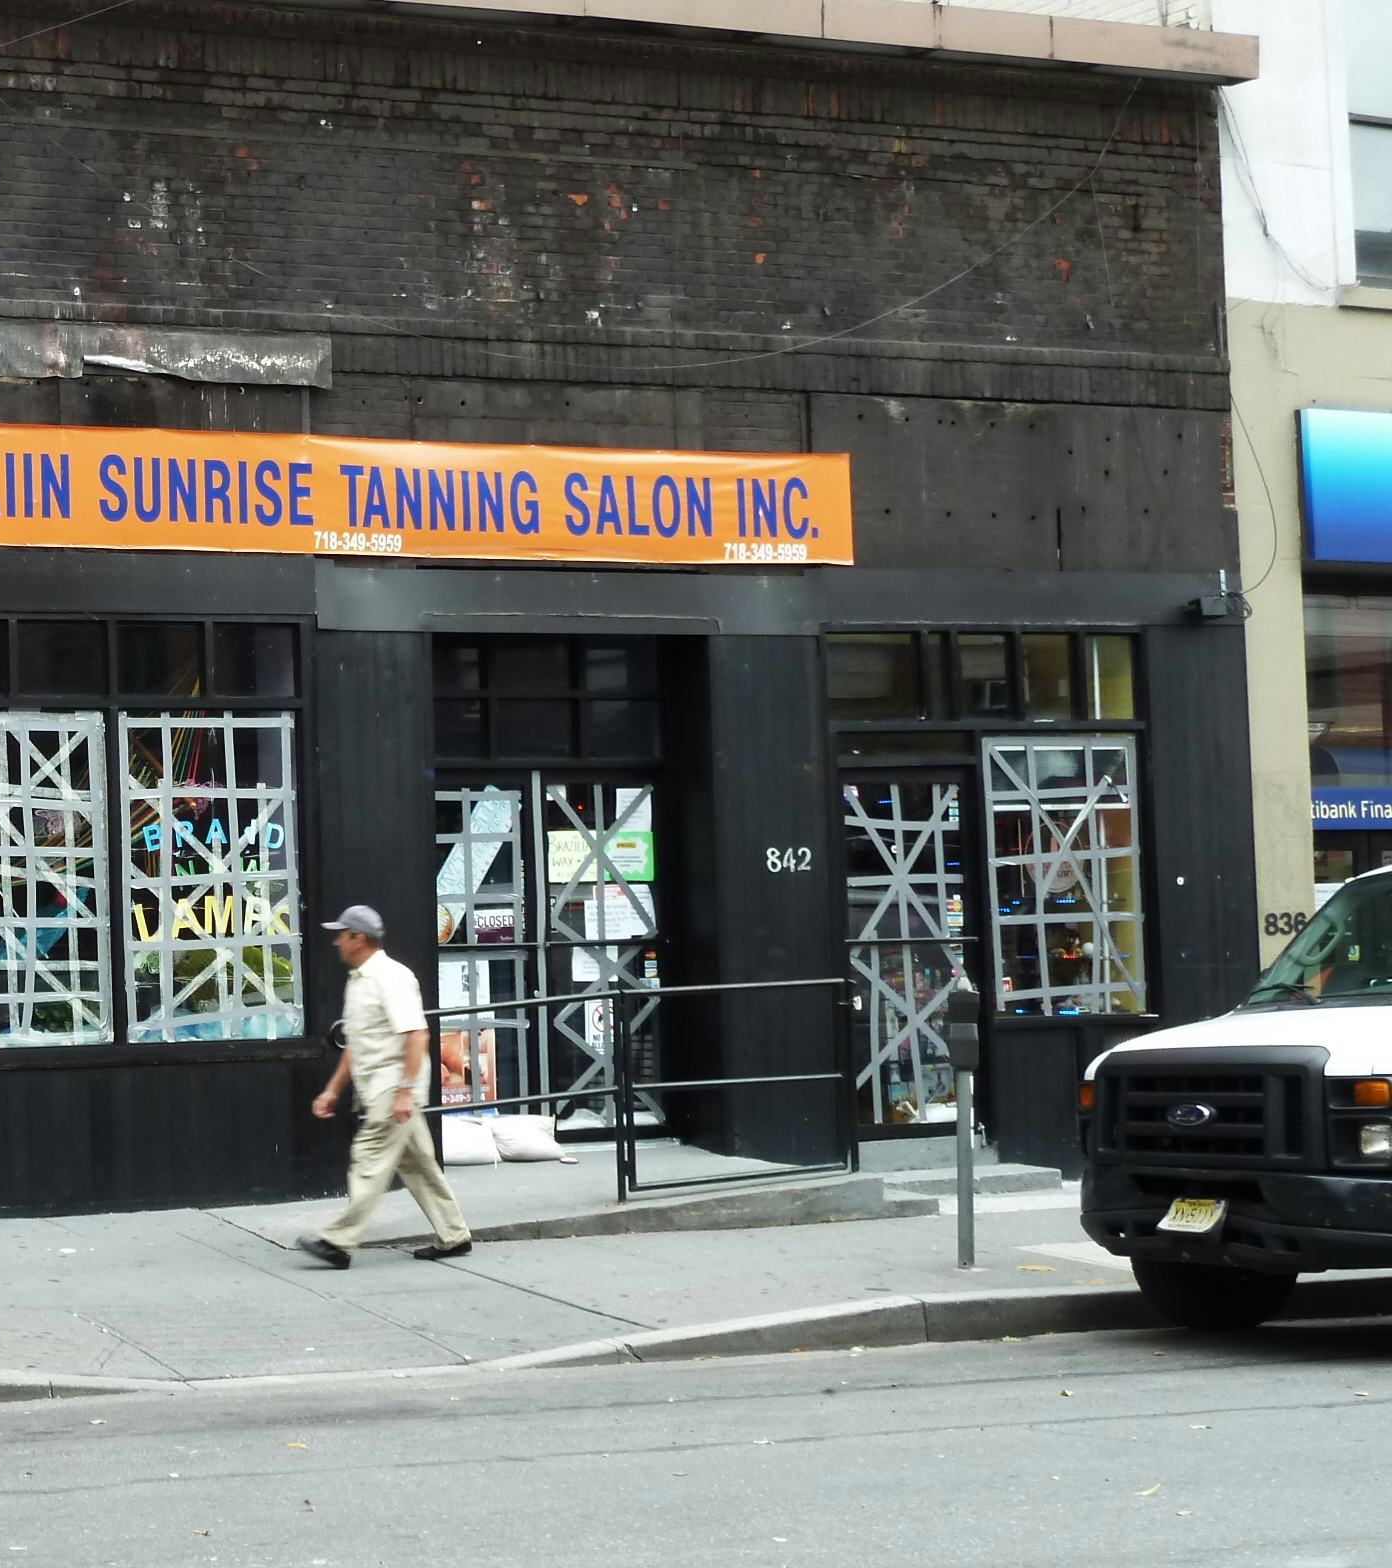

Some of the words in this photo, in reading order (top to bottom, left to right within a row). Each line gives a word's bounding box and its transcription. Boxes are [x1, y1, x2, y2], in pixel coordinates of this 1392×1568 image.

[98, 453, 314, 528] SUNRISE
[339, 463, 540, 535] TANNING
[564, 471, 712, 539] SALON
[737, 476, 819, 540] INC.
[312, 530, 403, 553] 718-349-5959
[723, 542, 808, 562] 718-349-5959
[766, 847, 812, 873] 842
[477, 914, 514, 929] CLOSED
[1264, 911, 1308, 937] 836
